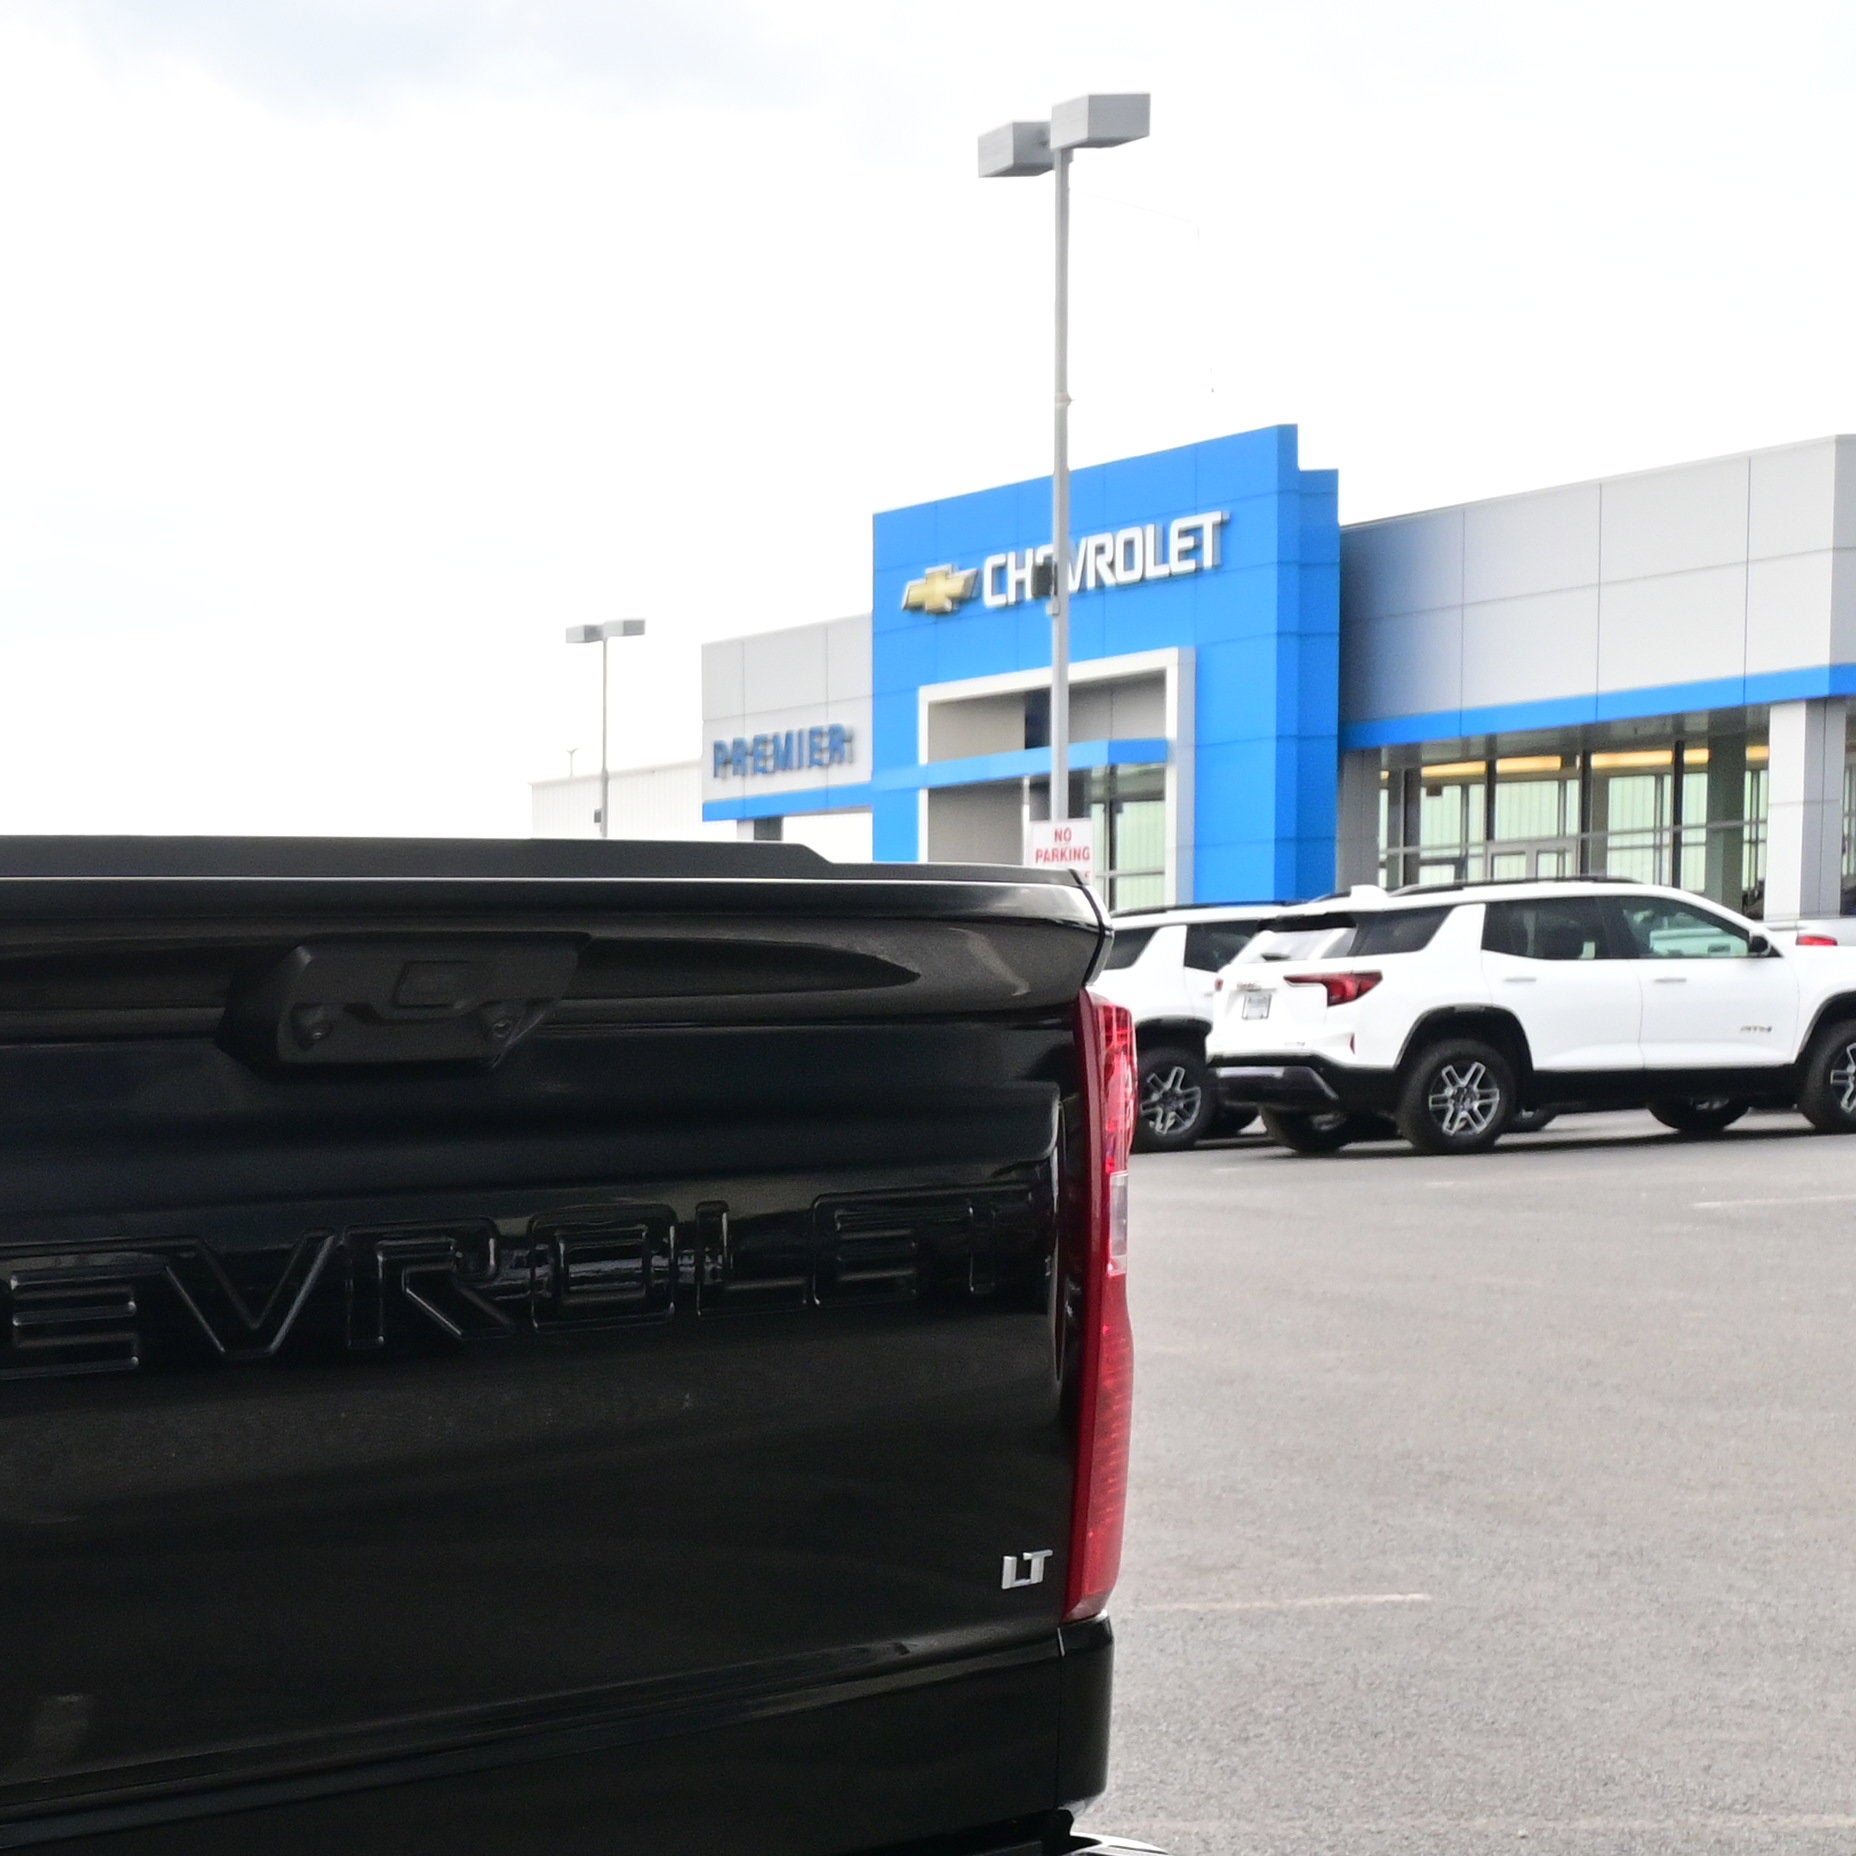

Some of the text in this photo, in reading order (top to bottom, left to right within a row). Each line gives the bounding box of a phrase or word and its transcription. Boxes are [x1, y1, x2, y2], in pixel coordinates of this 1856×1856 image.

[983, 510, 1226, 608] CHVROLET
[713, 723, 850, 779] PREMIER
[1035, 846, 1091, 863] PARKING
[1054, 827, 1073, 842] NO
[1001, 1549, 1054, 1590] LT
